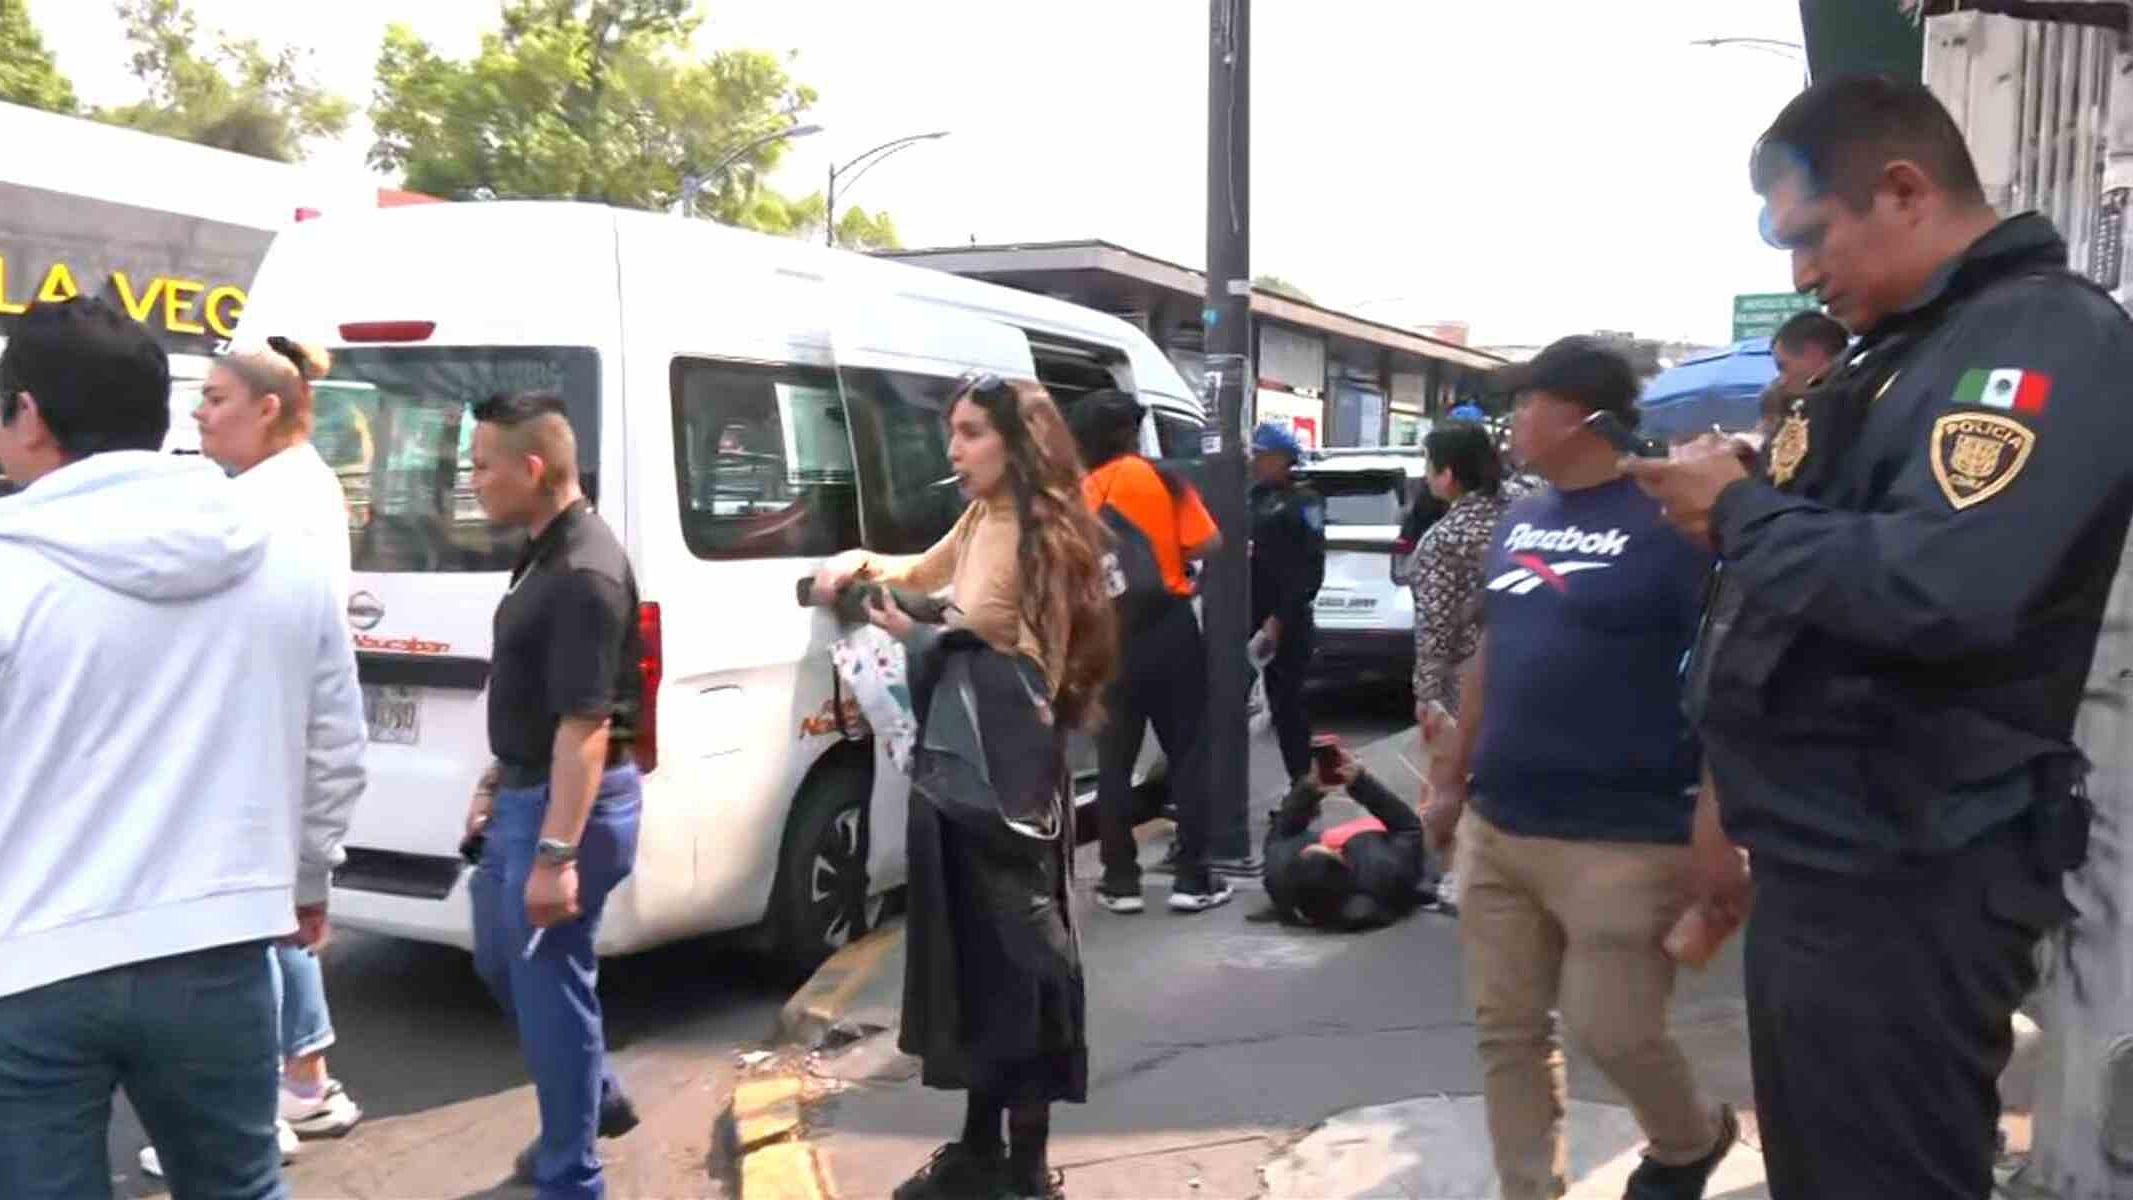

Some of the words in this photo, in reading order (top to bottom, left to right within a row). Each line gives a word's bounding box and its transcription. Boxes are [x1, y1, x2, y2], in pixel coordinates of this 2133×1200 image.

[0, 255, 78, 314] LA
[1945, 420, 2023, 449] POLICIA
[1504, 523, 1630, 556] Reebok
